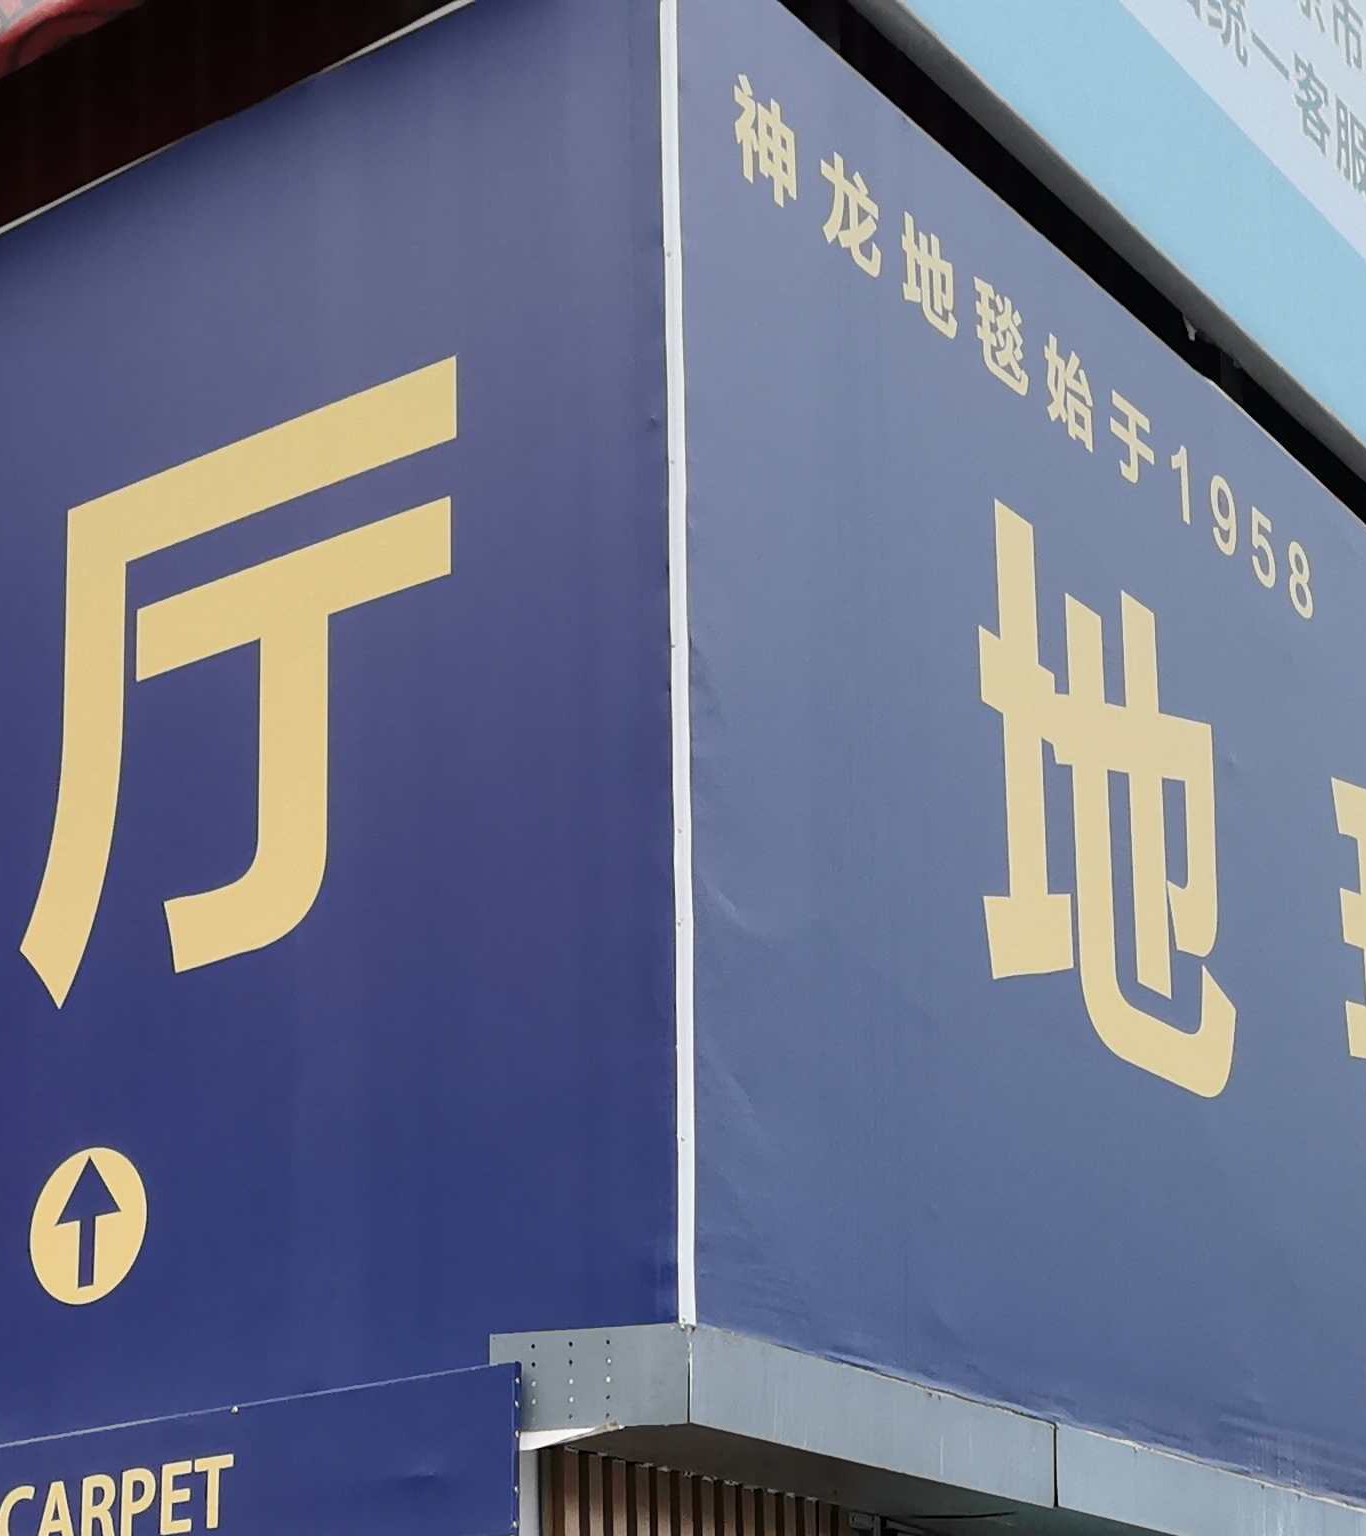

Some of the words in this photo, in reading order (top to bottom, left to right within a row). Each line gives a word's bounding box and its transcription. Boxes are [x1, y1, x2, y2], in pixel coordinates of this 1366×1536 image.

[734, 73, 1313, 620] 神龙地毯始于1958
